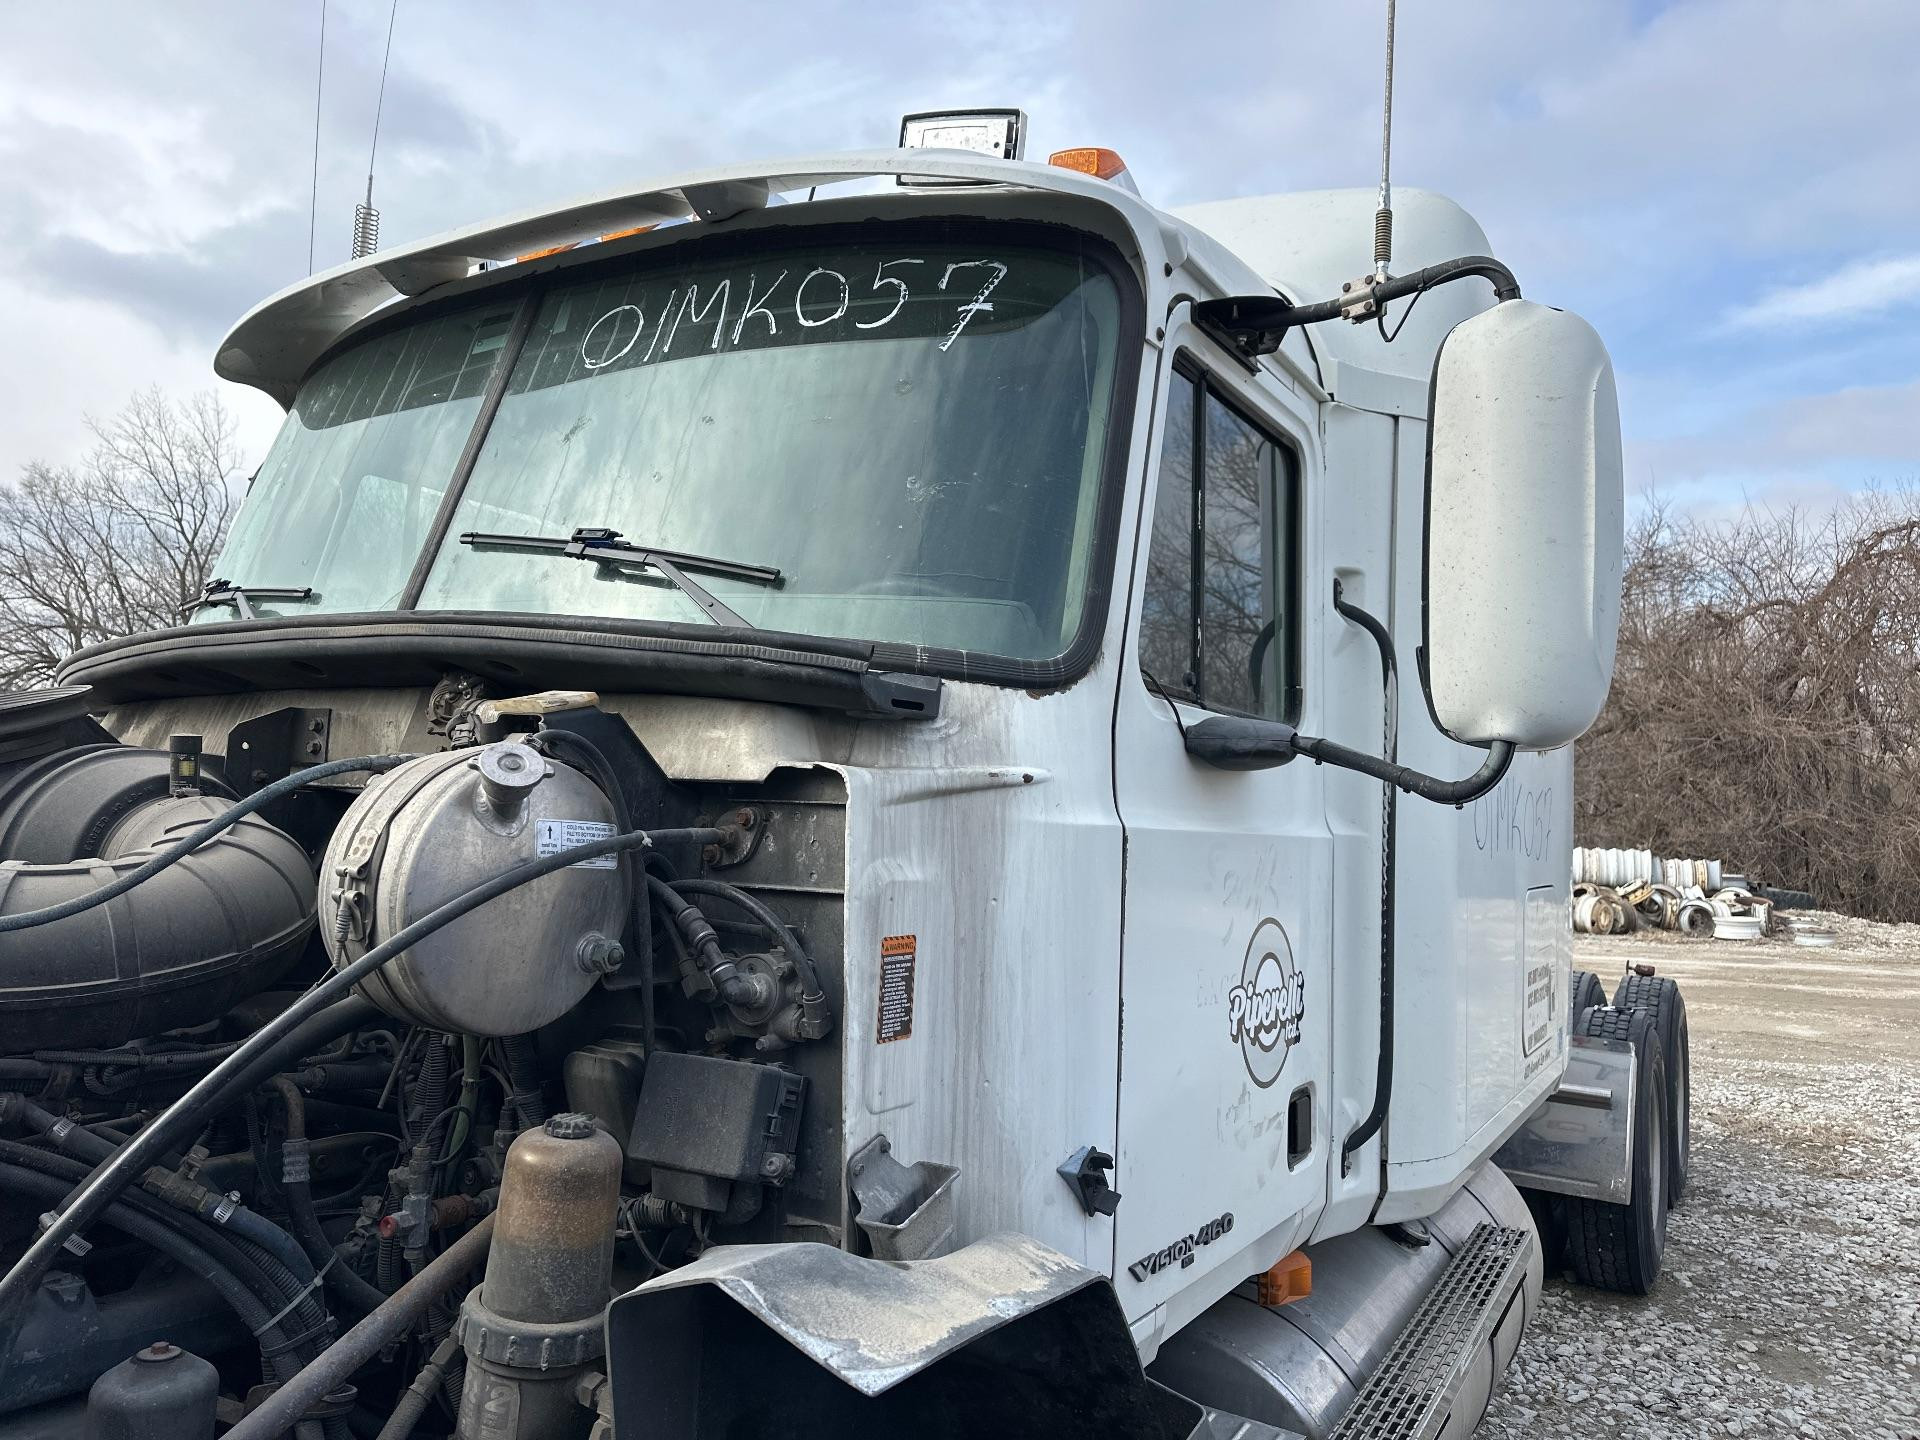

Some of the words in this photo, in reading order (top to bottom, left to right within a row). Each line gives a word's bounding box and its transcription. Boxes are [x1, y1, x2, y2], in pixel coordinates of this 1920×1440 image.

[889, 942, 914, 951] WARNING
[1229, 970, 1305, 1044] Piperelli
[1128, 1234, 1195, 1282] VISION
[1195, 1212, 1234, 1246] 460
